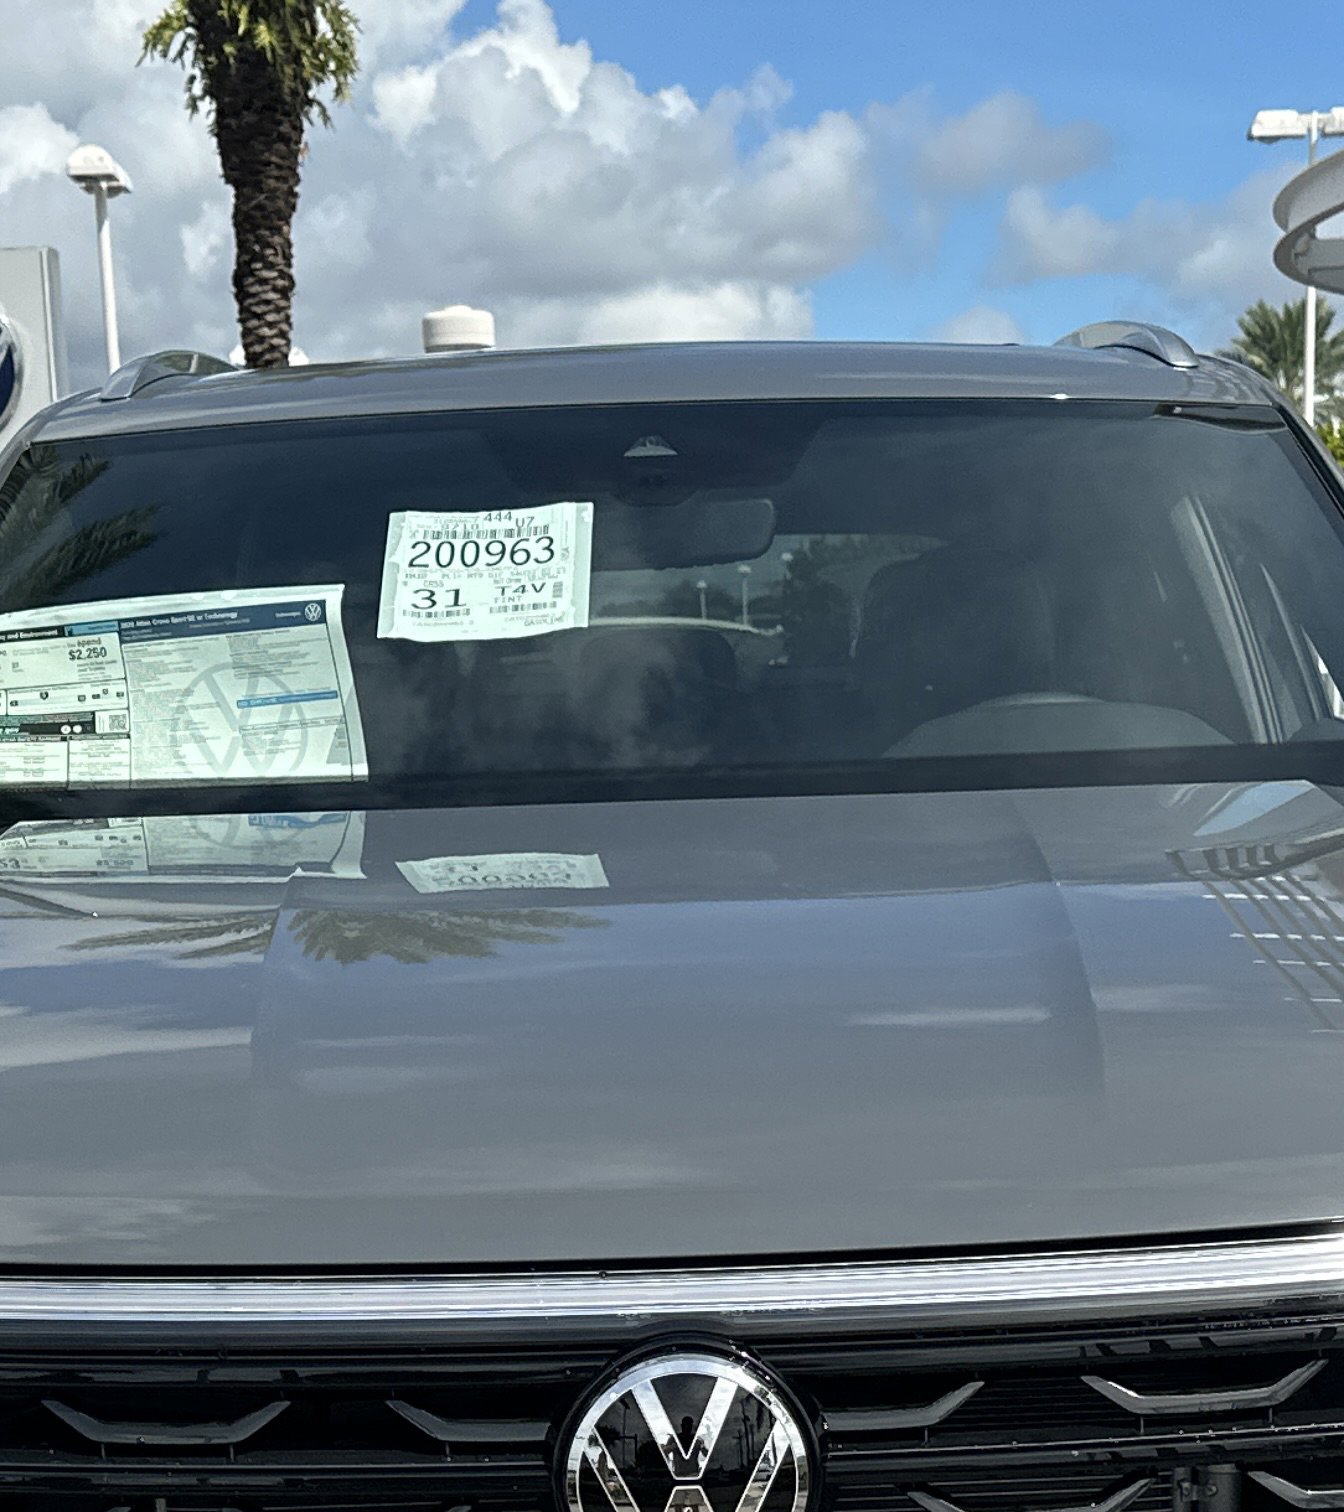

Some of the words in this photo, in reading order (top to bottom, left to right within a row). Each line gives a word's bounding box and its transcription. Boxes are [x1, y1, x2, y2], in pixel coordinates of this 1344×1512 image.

[407, 535, 556, 569] 200963
[411, 587, 467, 610] 31
[494, 582, 547, 597] T4V
